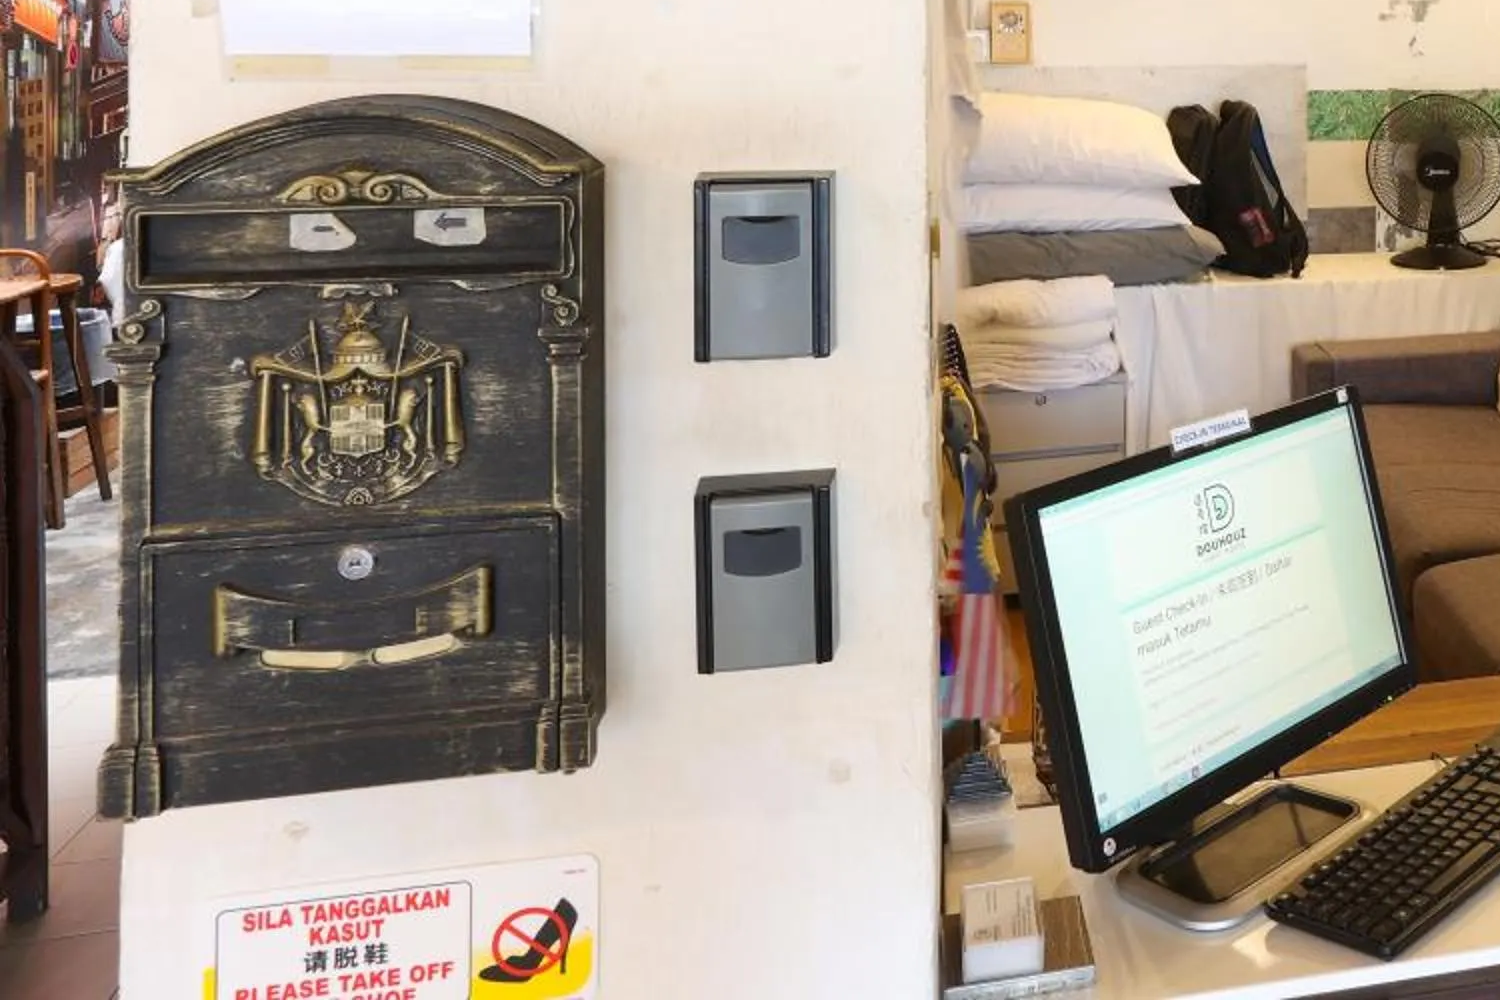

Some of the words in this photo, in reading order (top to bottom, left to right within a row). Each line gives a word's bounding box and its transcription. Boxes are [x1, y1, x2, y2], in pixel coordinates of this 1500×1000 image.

[1196, 527, 1247, 557] DOUHOUZ
[242, 908, 293, 932] SILA
[300, 888, 451, 925] TANGGALKAN
[308, 919, 385, 947] KASUT
[304, 943, 390, 974] 请脱鞋
[234, 977, 330, 1000] PLEASE
[338, 967, 401, 993] TAKE
[409, 961, 455, 983] OFF
[351, 988, 417, 1000] OE
